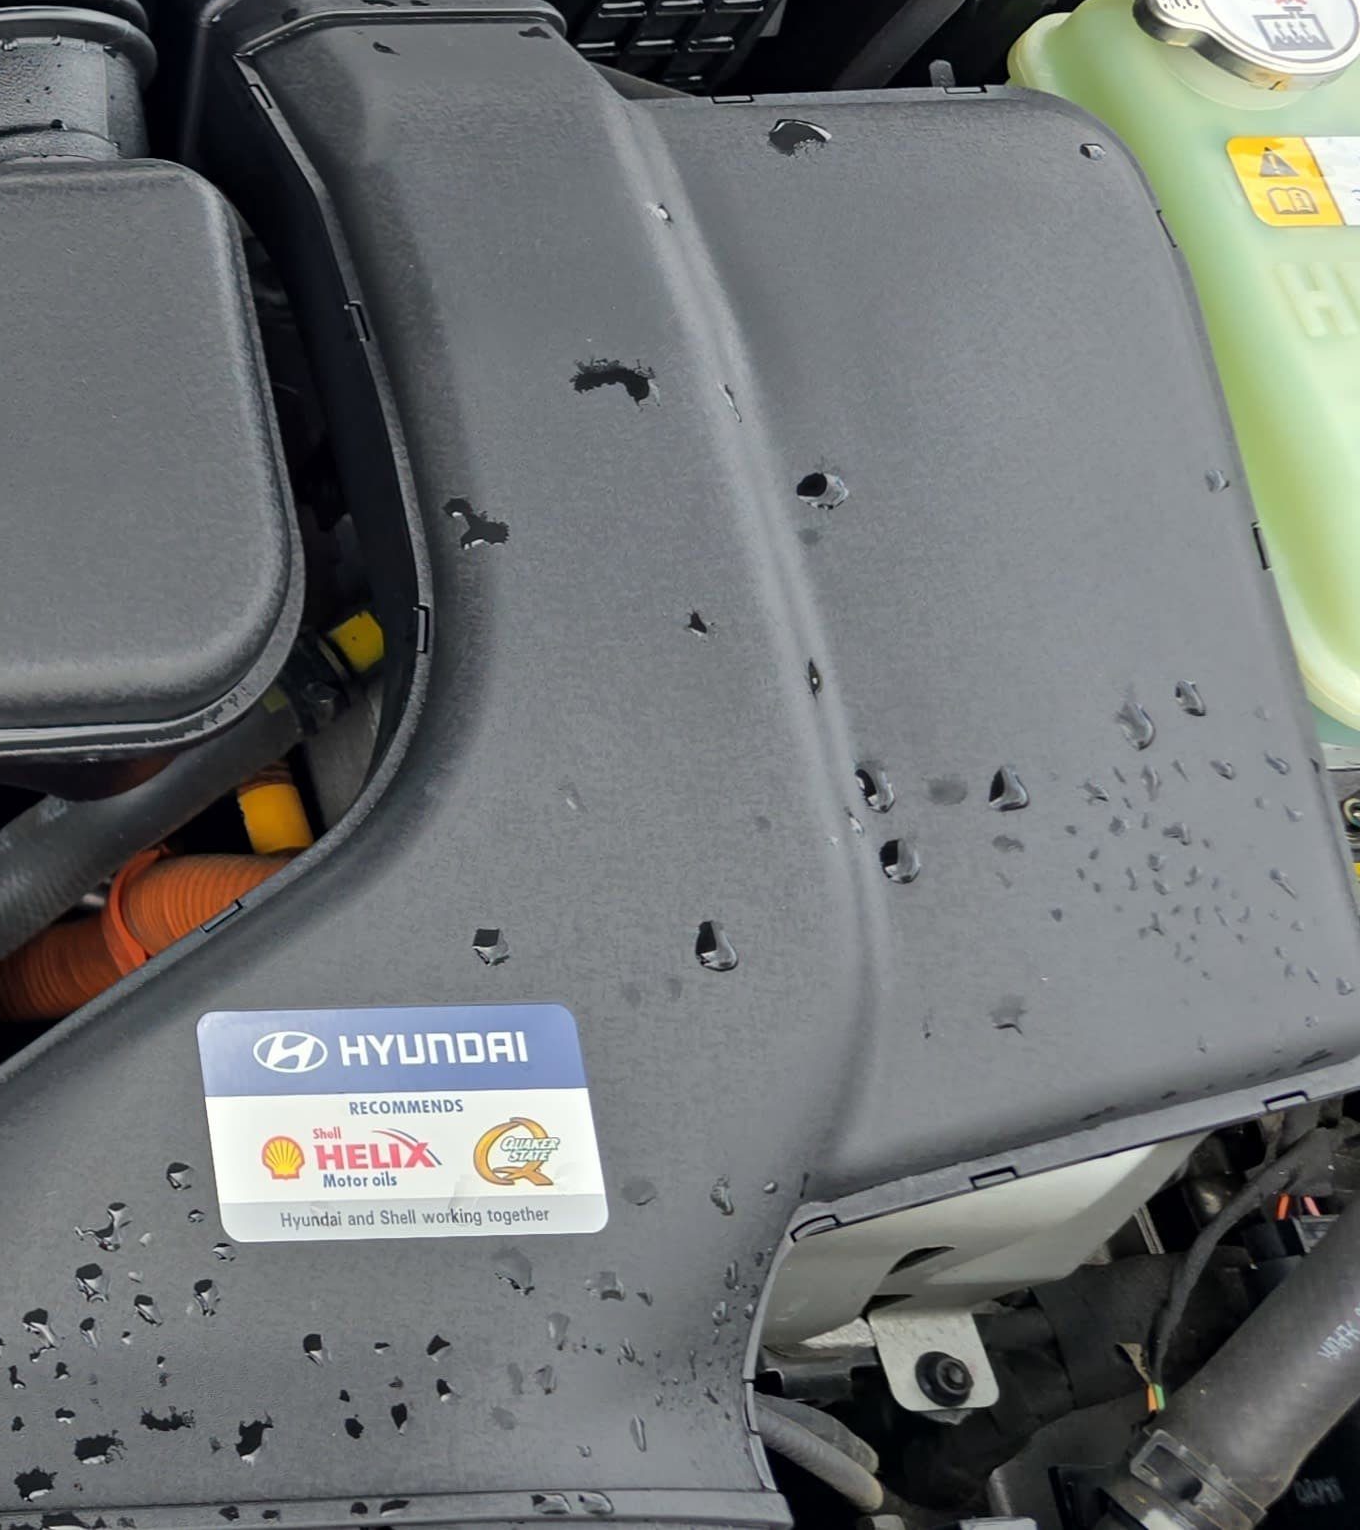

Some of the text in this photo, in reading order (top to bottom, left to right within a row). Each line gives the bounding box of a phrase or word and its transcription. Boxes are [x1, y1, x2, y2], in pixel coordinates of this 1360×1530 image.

[339, 1030, 529, 1066] HYUNDAI
[349, 1099, 464, 1116] RECOMMENDS
[312, 1126, 342, 1140] Shell
[500, 1134, 561, 1153] QUAKER
[314, 1142, 438, 1171] HELIX
[507, 1148, 552, 1163] STATE
[322, 1172, 398, 1189] Motor oils
[280, 1206, 551, 1229] Hyundai and Shell working together
